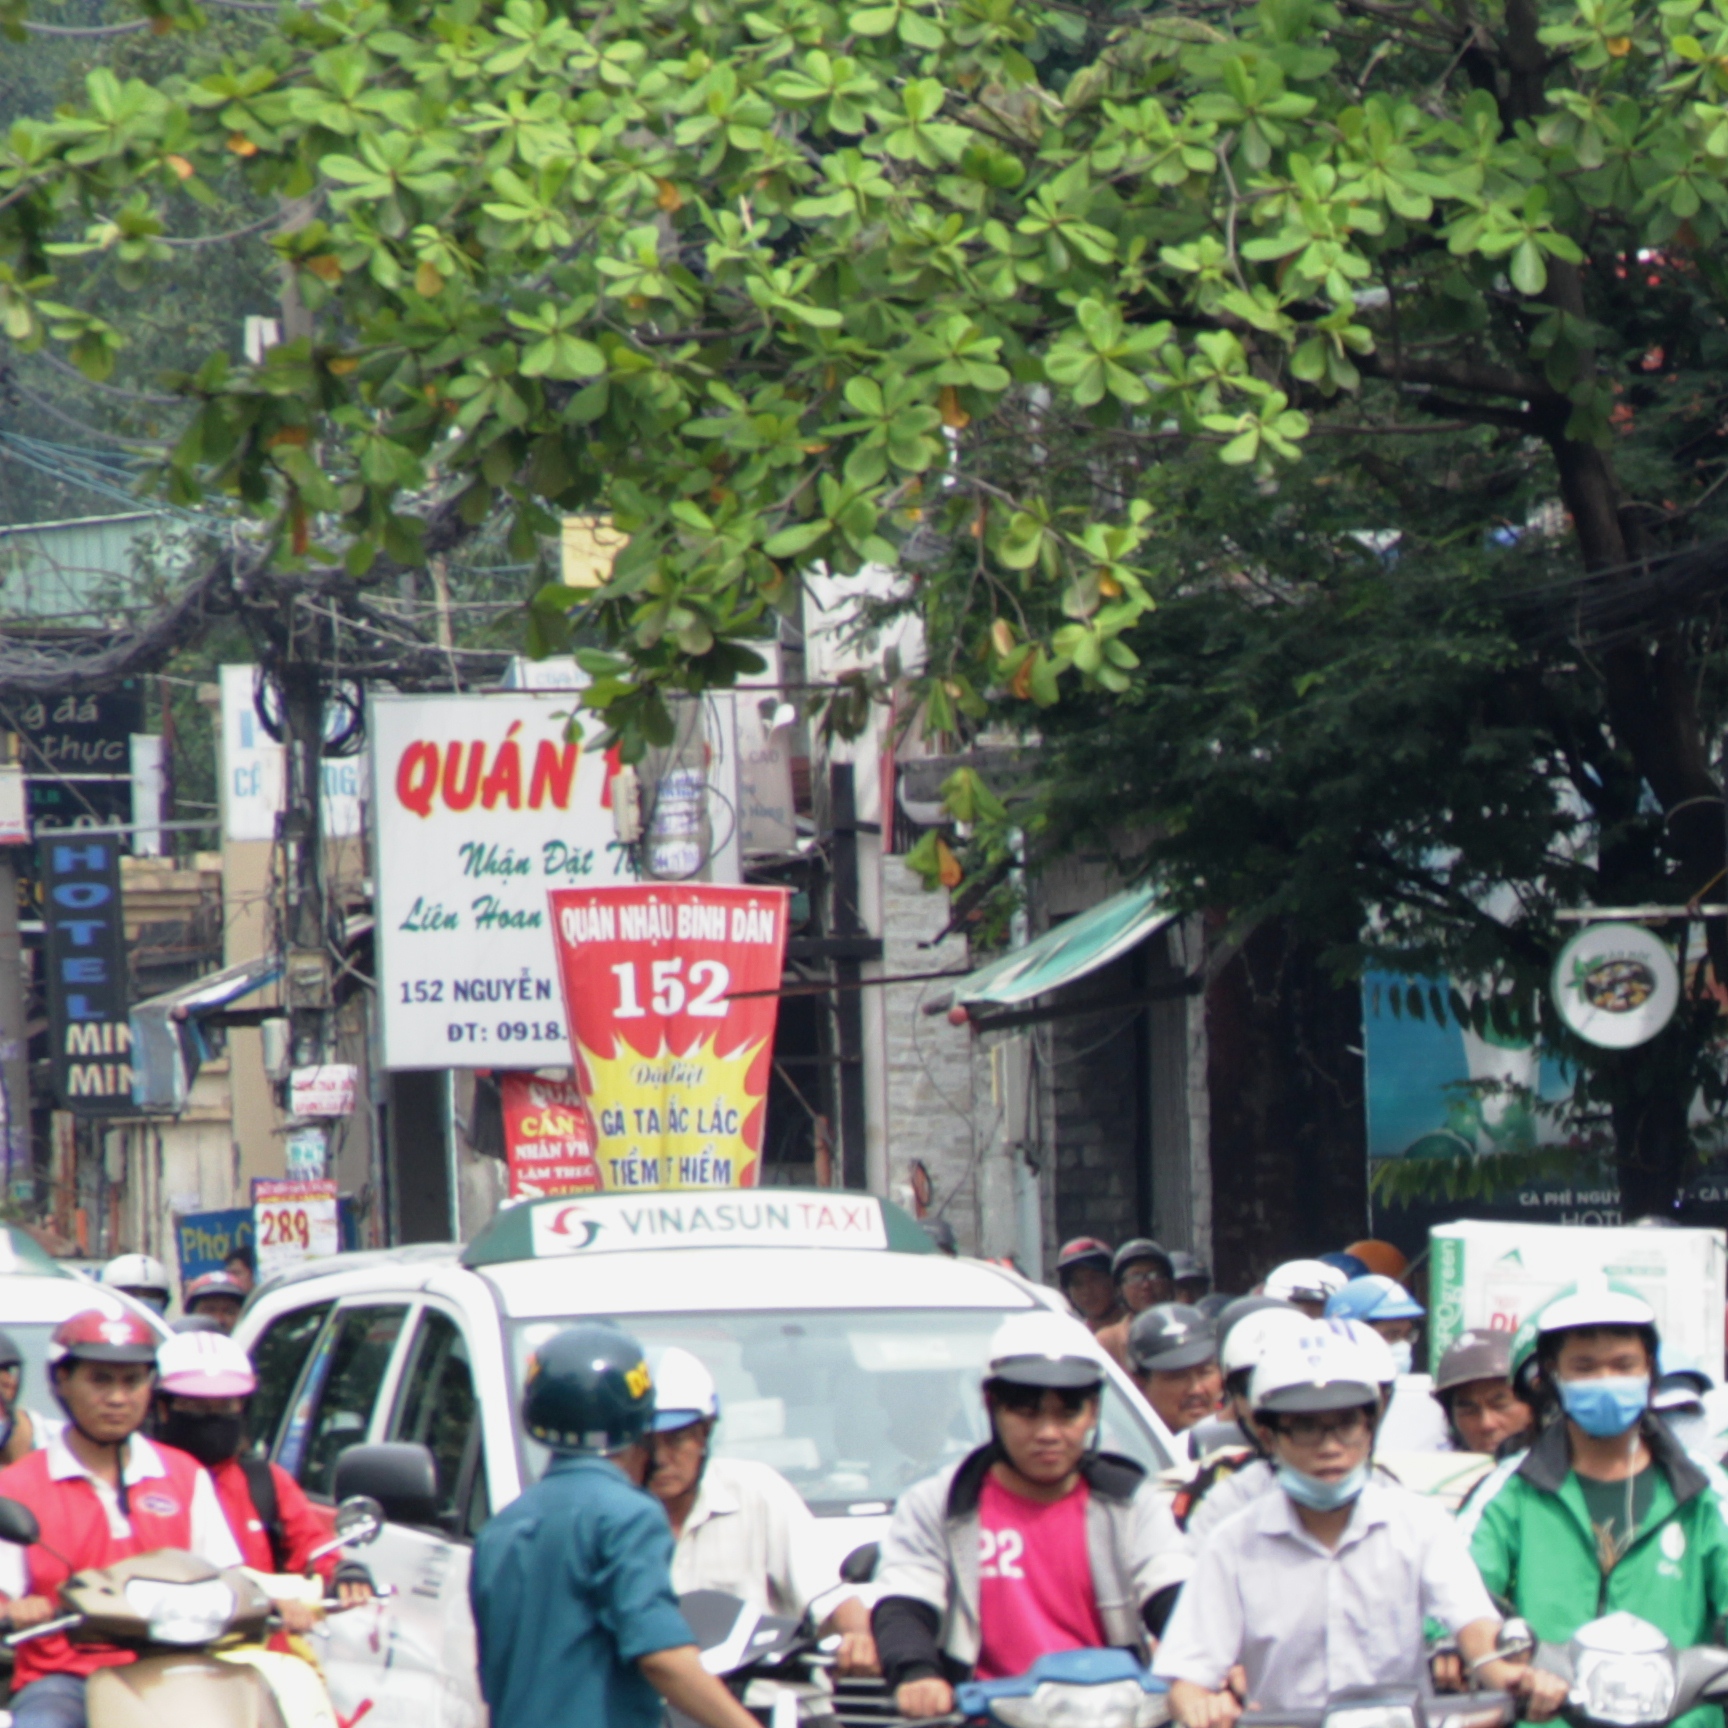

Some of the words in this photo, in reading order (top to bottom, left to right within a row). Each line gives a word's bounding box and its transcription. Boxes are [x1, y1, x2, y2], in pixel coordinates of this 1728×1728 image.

[395, 719, 580, 820] QUÁN
[458, 840, 531, 886] Nhận
[542, 839, 594, 884] Đặt
[52, 845, 112, 1020] HOTEL
[398, 896, 459, 932] Liên
[471, 894, 542, 931] Hoan
[561, 897, 616, 948] QUÁN
[619, 896, 674, 947] NHẬU
[677, 895, 726, 942] BÌNH
[731, 899, 774, 944] DÂN
[400, 979, 444, 1004] 152
[453, 967, 551, 1002] NGUYỄN
[611, 956, 731, 1019] 152
[65, 1021, 136, 1056] MIN
[447, 1022, 488, 1043] ĐT:
[67, 1063, 137, 1097] MIN
[601, 1103, 626, 1137] GÀ
[698, 1093, 738, 1136] LẮC
[1577, 1190, 1621, 1206] NGUY
[260, 1208, 310, 1250] 289
[619, 1203, 791, 1236] VINASUN
[797, 1202, 872, 1232] TAXI
